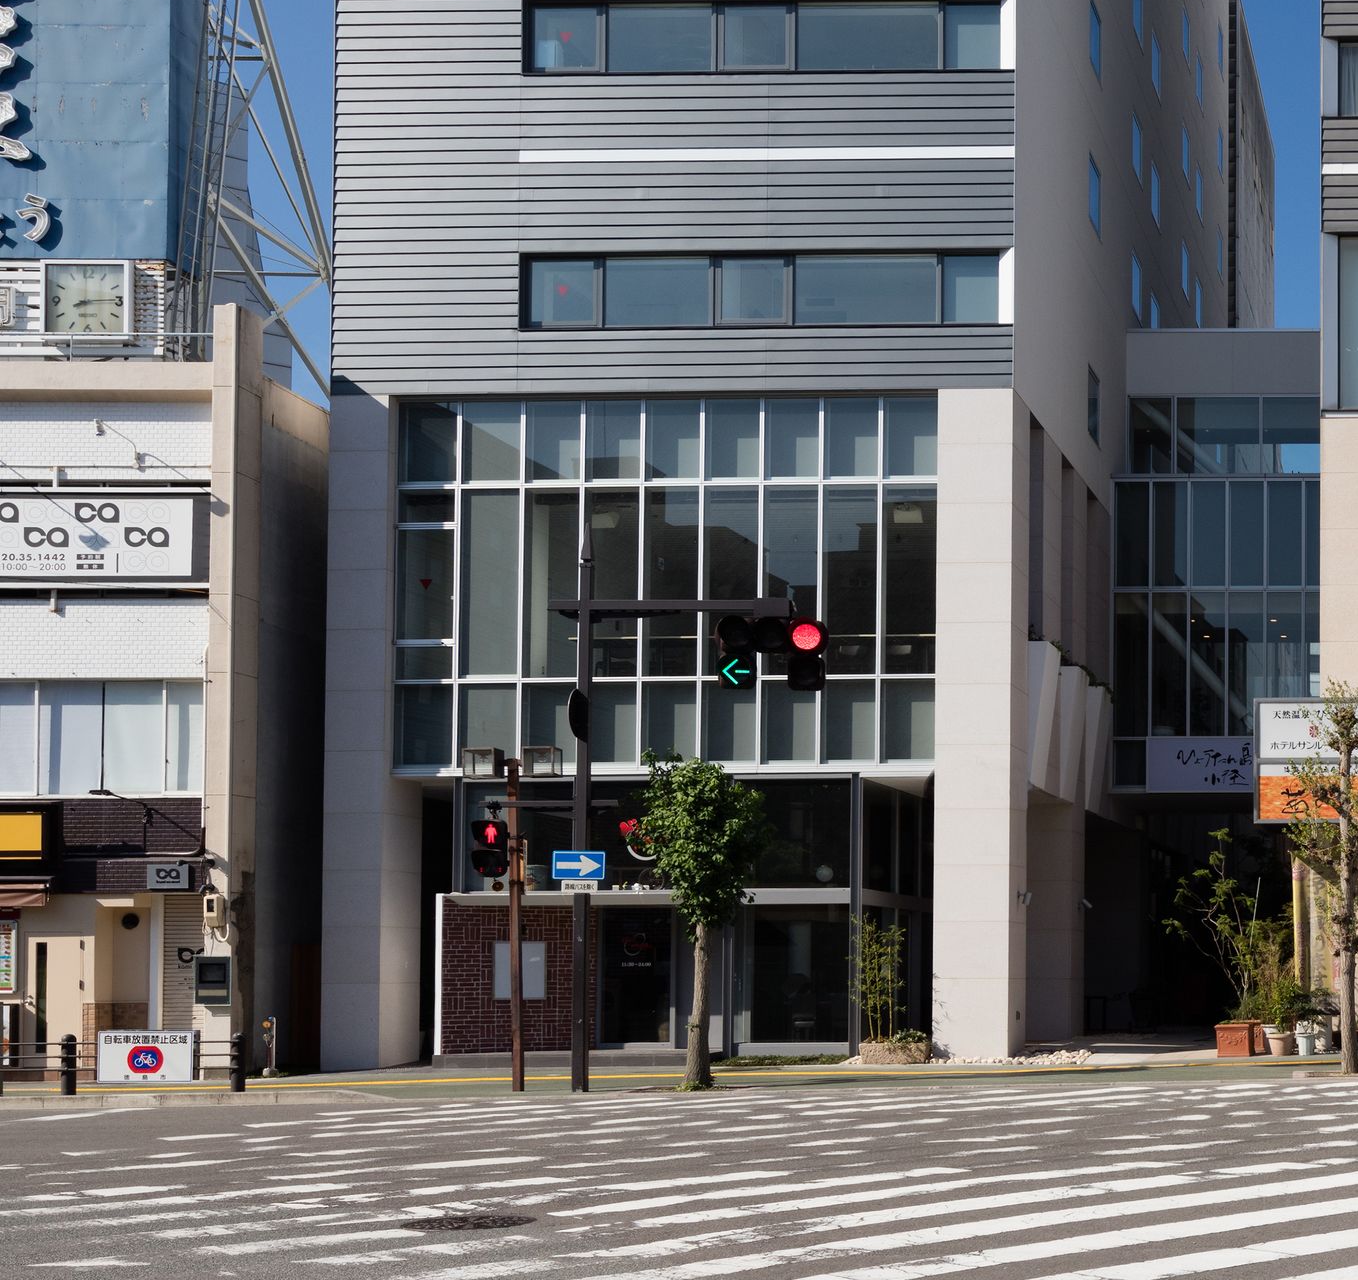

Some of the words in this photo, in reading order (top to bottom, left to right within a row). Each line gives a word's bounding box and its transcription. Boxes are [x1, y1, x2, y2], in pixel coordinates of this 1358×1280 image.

[52, 296, 62, 307] 9
[114, 296, 123, 307] 3
[1270, 741, 1323, 750] ホテルサンル
[104, 1035, 188, 1045] 自転車放置禁止区域
